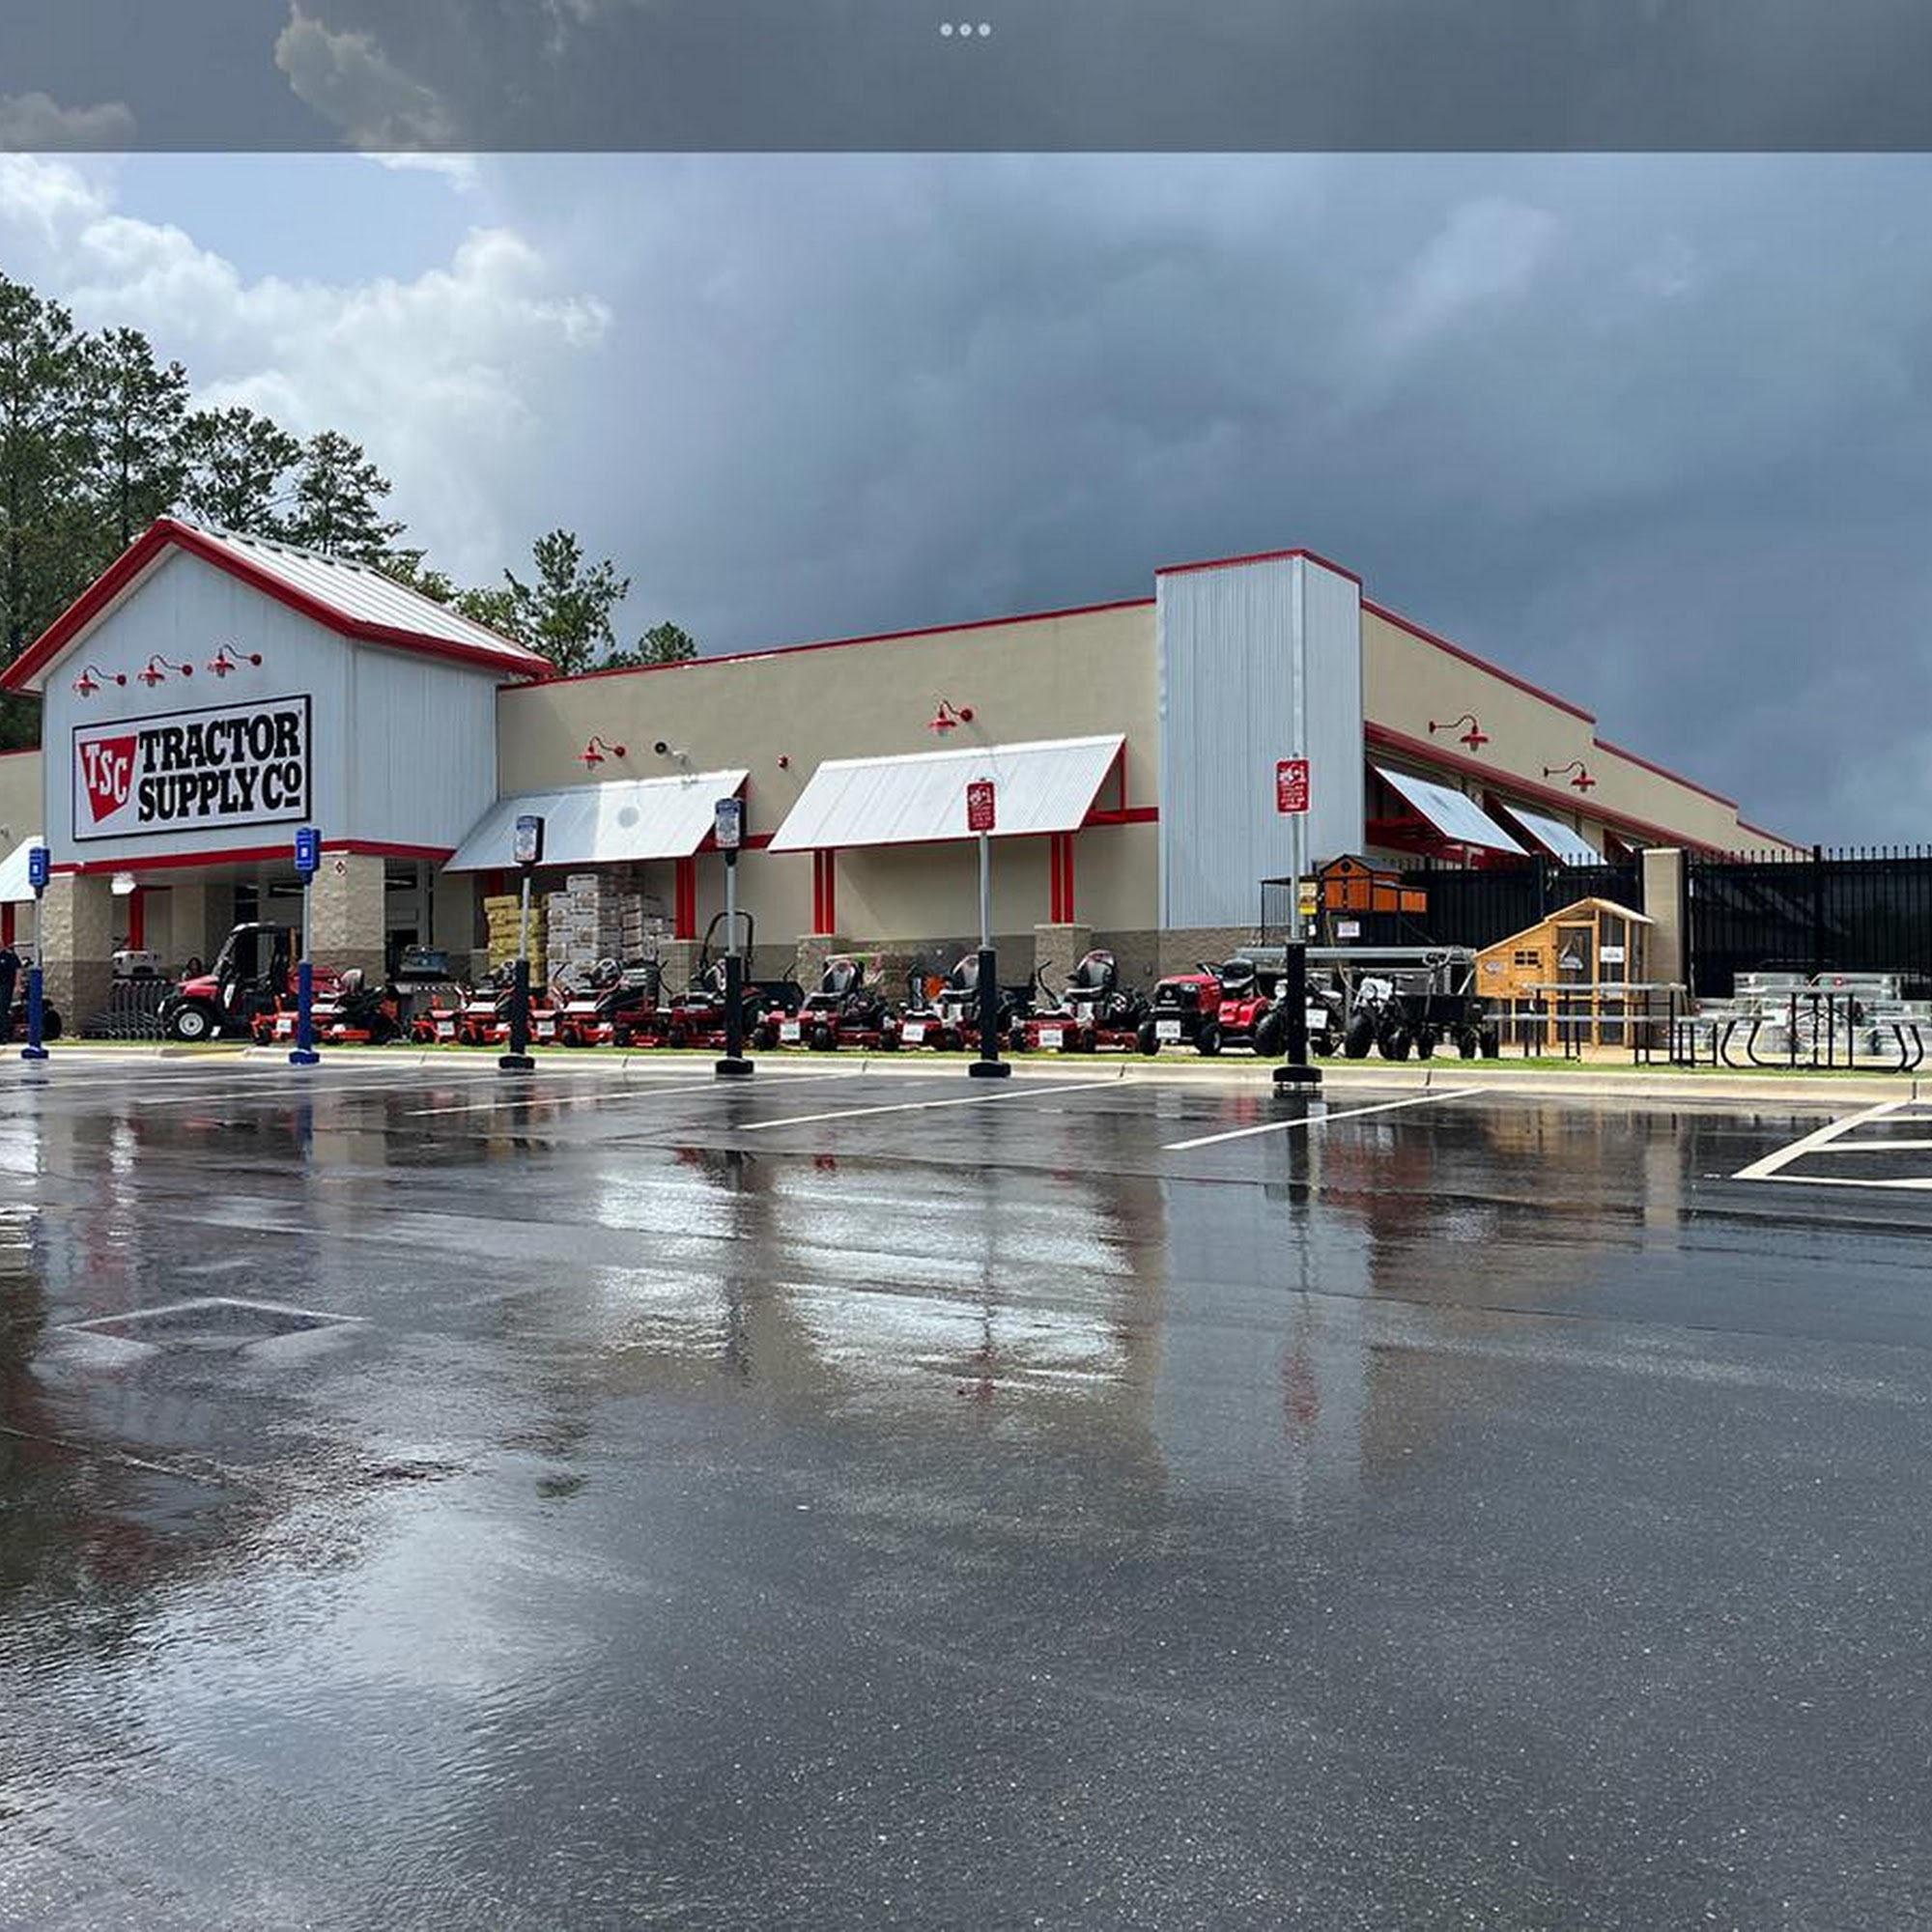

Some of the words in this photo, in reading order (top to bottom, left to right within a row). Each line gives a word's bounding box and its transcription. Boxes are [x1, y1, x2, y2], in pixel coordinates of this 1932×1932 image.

[85, 743, 128, 805] TSC
[139, 712, 300, 774] TRACTOR
[138, 766, 259, 822] SUPPLY
